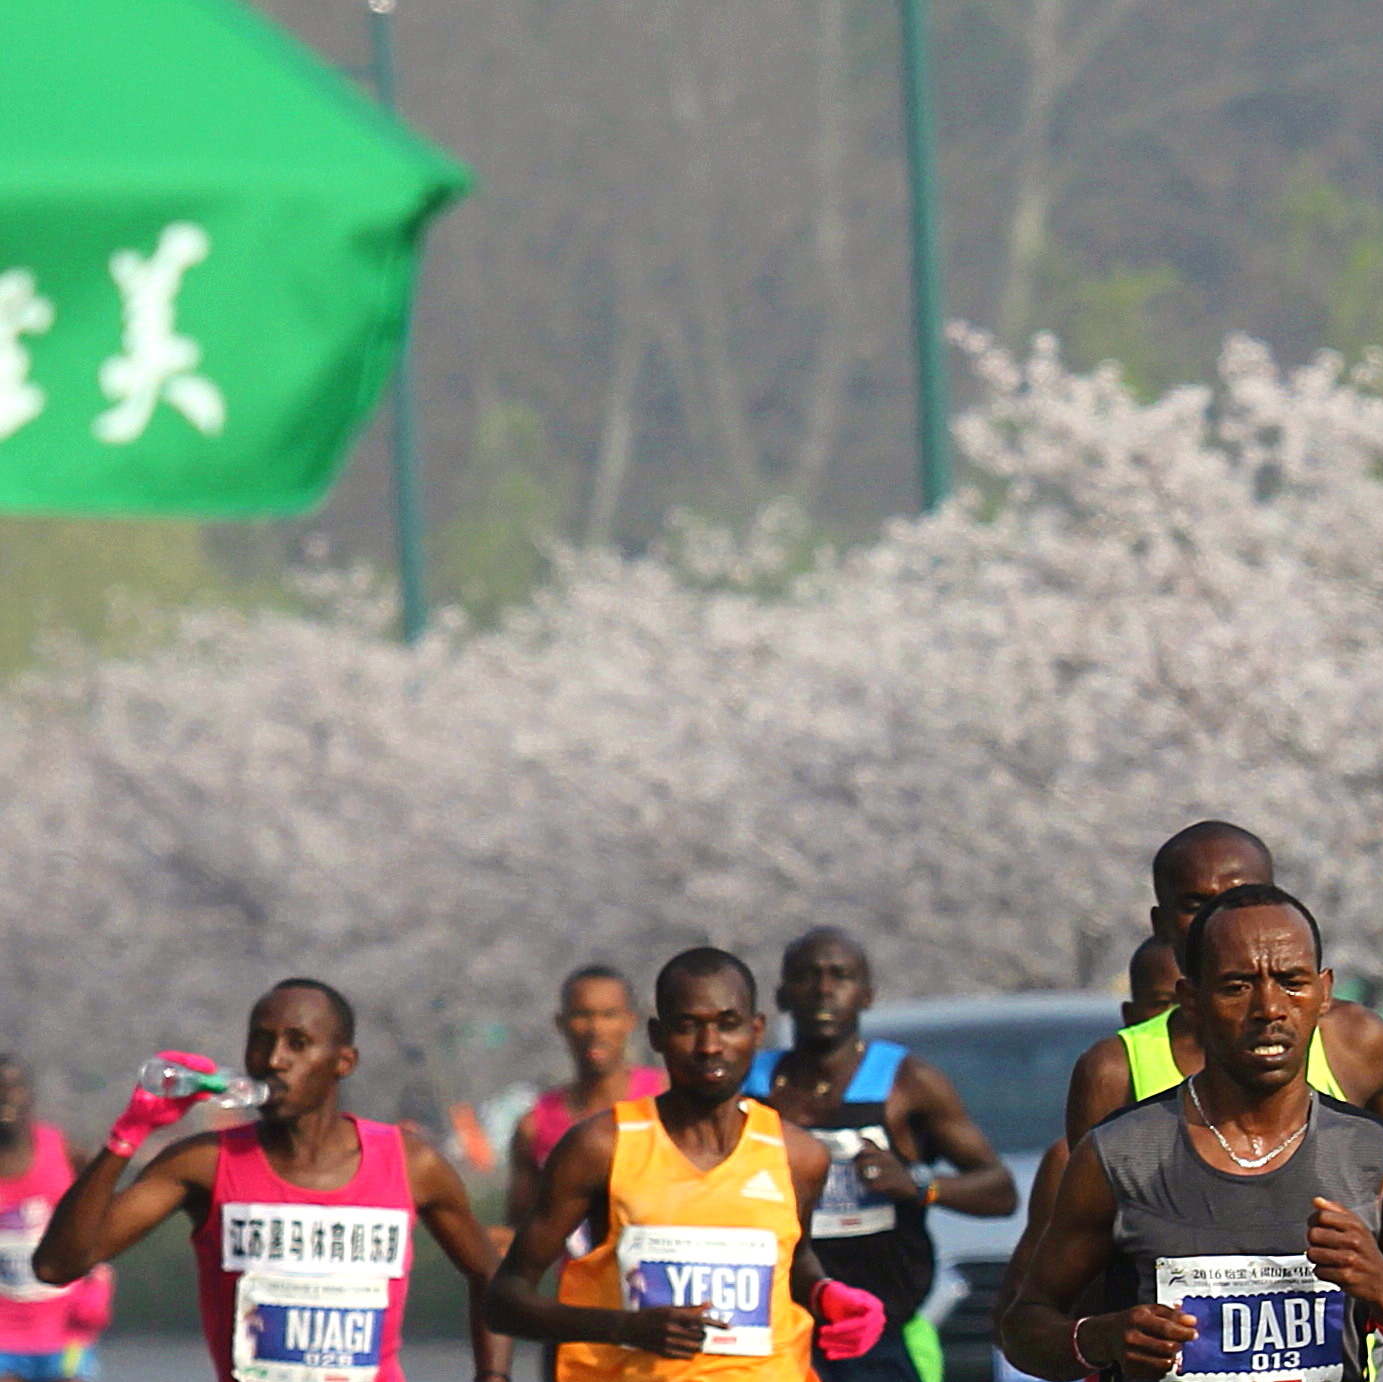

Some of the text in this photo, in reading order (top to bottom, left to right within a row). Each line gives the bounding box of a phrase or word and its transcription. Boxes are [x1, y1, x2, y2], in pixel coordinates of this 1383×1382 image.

[666, 1265, 760, 1312] YEGO
[284, 1309, 373, 1354] NJAGI
[1222, 1297, 1327, 1353] DABI
[1250, 1351, 1301, 1371] 013
